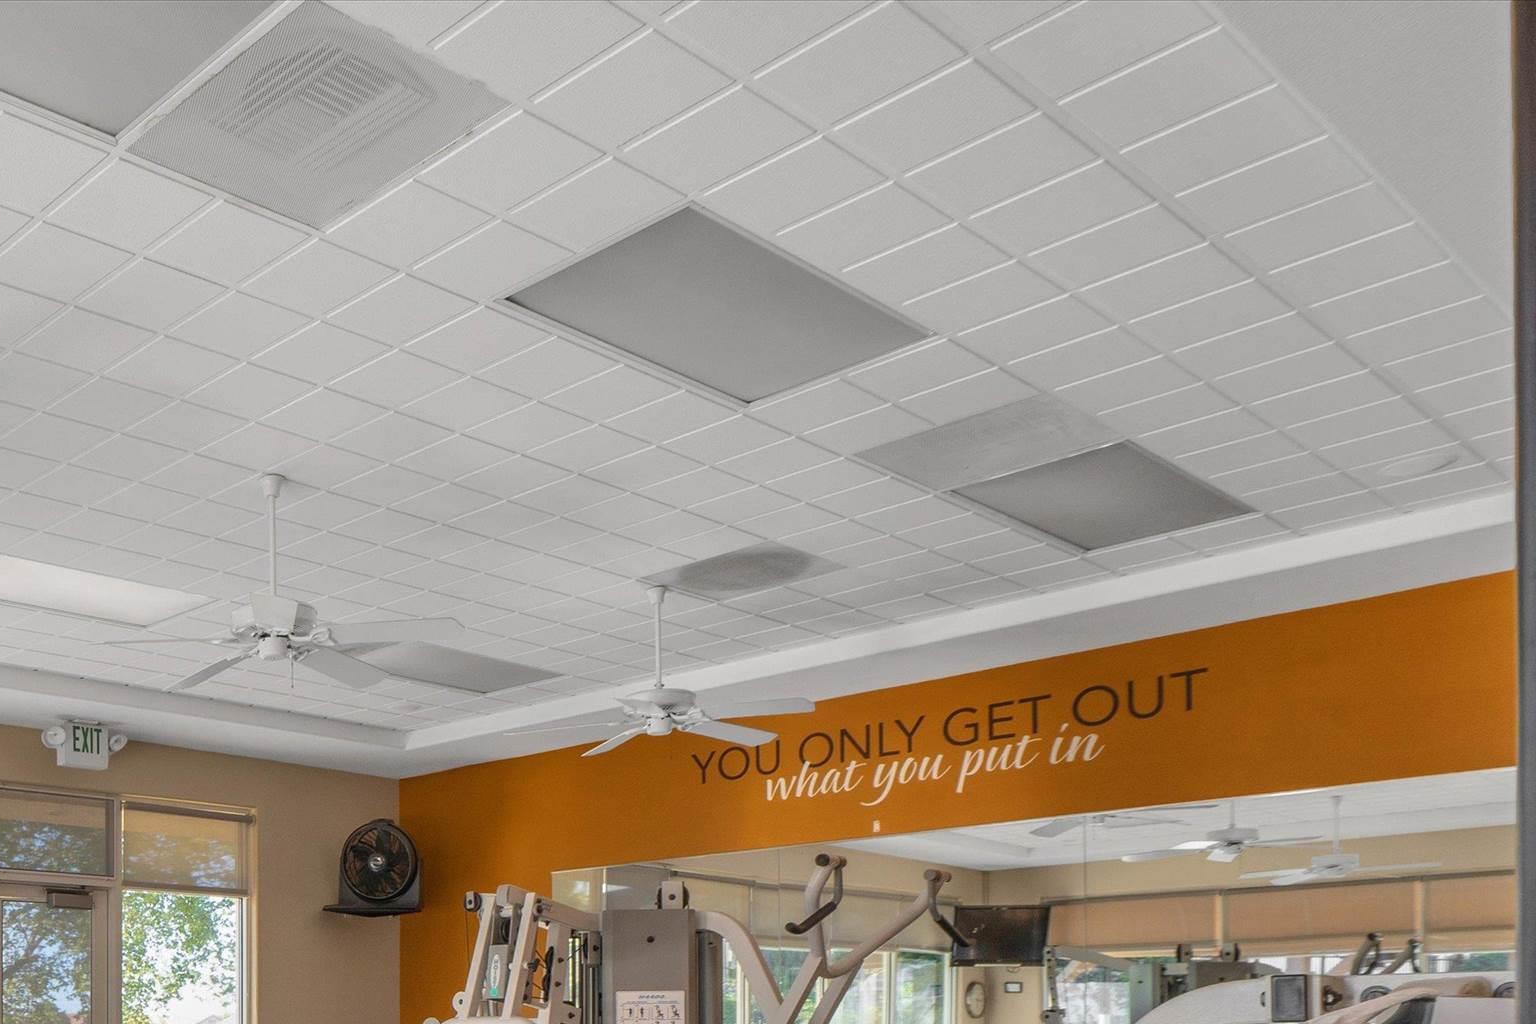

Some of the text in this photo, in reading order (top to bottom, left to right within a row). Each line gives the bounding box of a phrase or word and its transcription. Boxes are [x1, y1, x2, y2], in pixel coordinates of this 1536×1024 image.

[72, 725, 103, 755] EXIT
[691, 667, 1209, 785] YOU ONLY GET OUT
[765, 722, 1105, 807] what you put in
